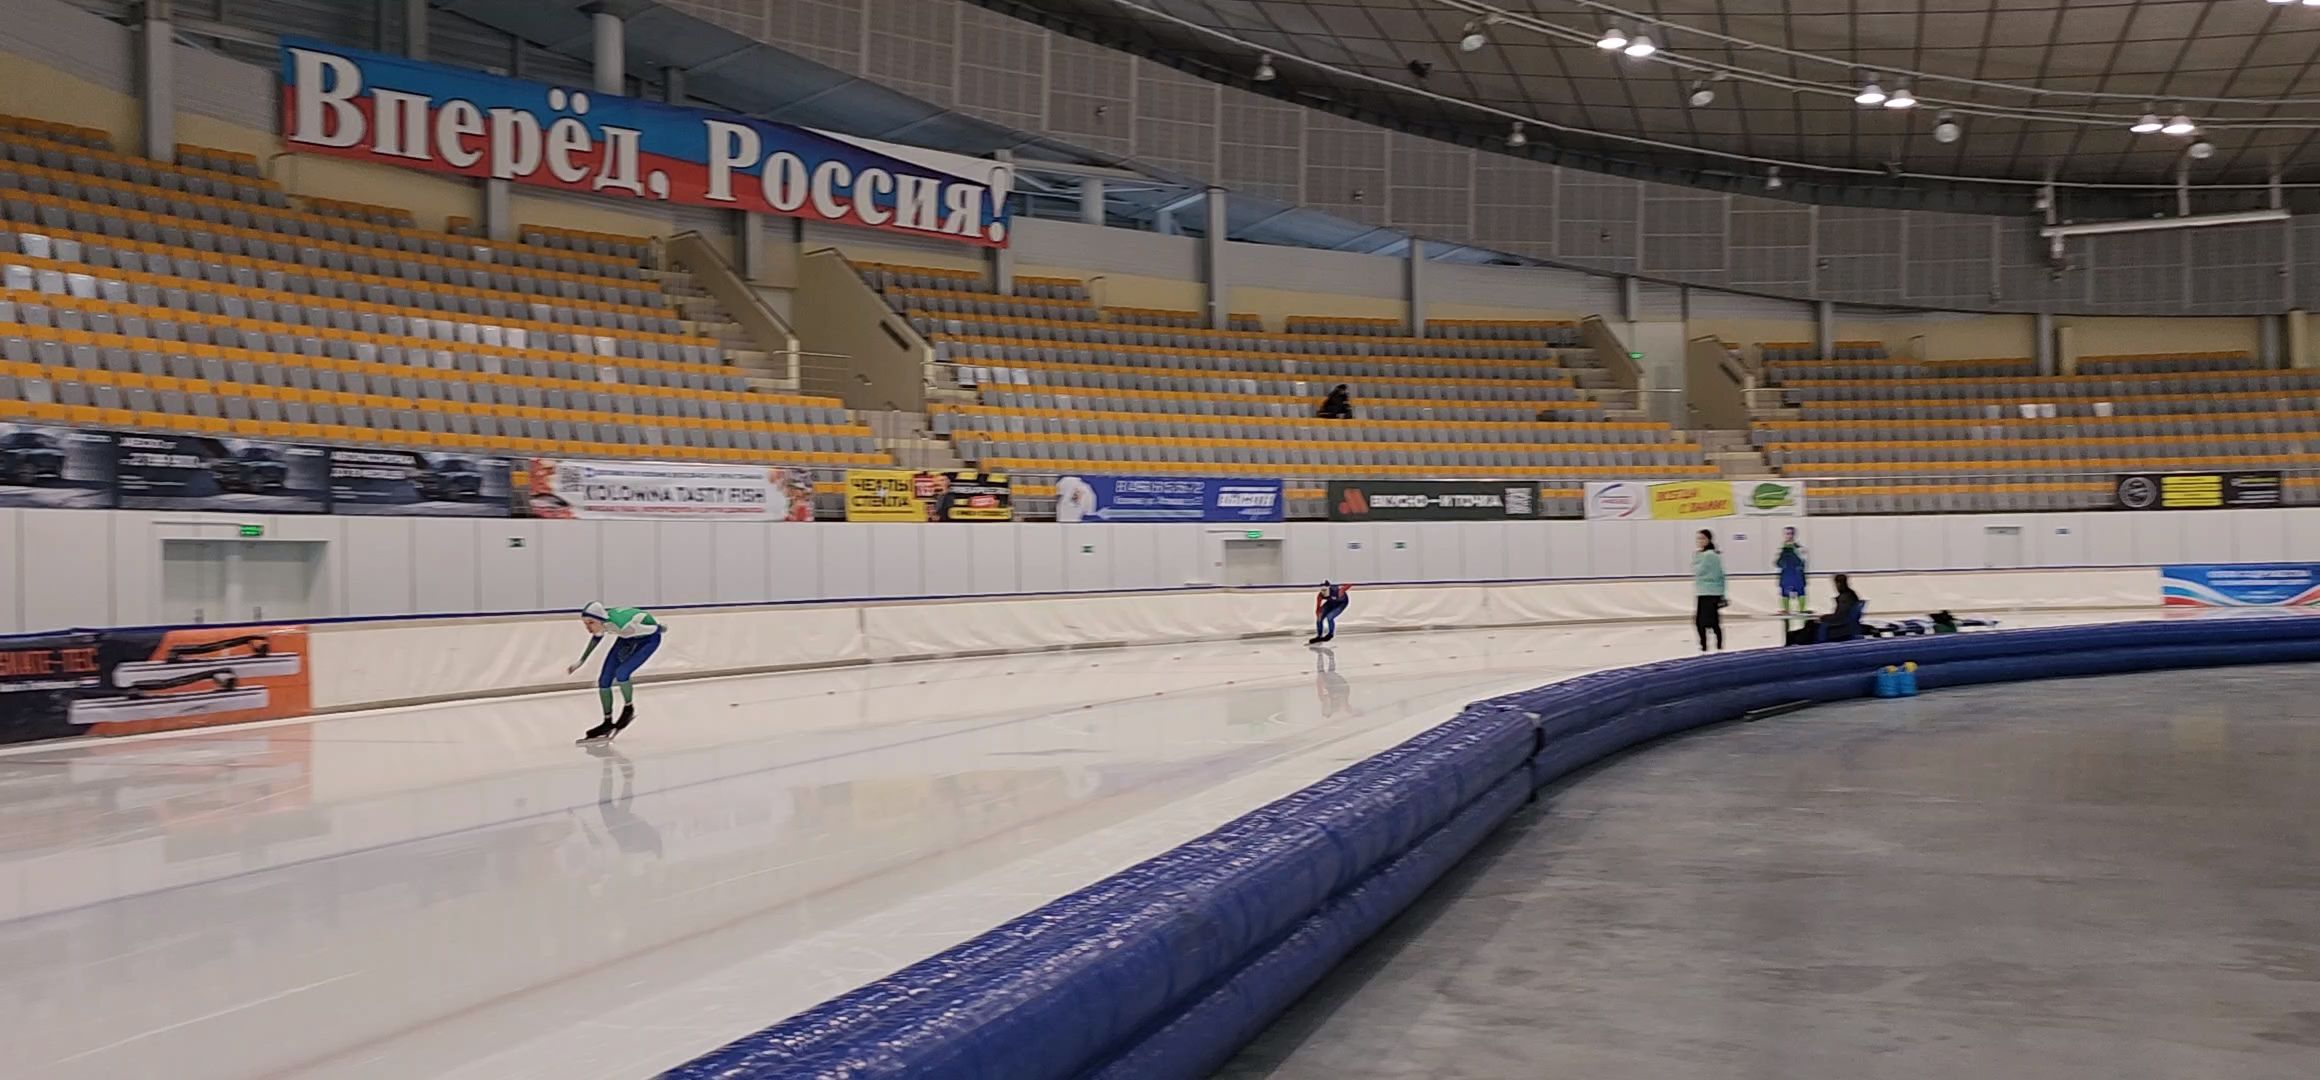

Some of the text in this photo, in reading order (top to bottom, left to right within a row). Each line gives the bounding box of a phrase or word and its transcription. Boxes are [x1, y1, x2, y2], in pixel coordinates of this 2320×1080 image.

[288, 47, 1010, 242] Вперёд, Россия!
[675, 486, 724, 503] TASTY
[728, 487, 766, 503] FISH
